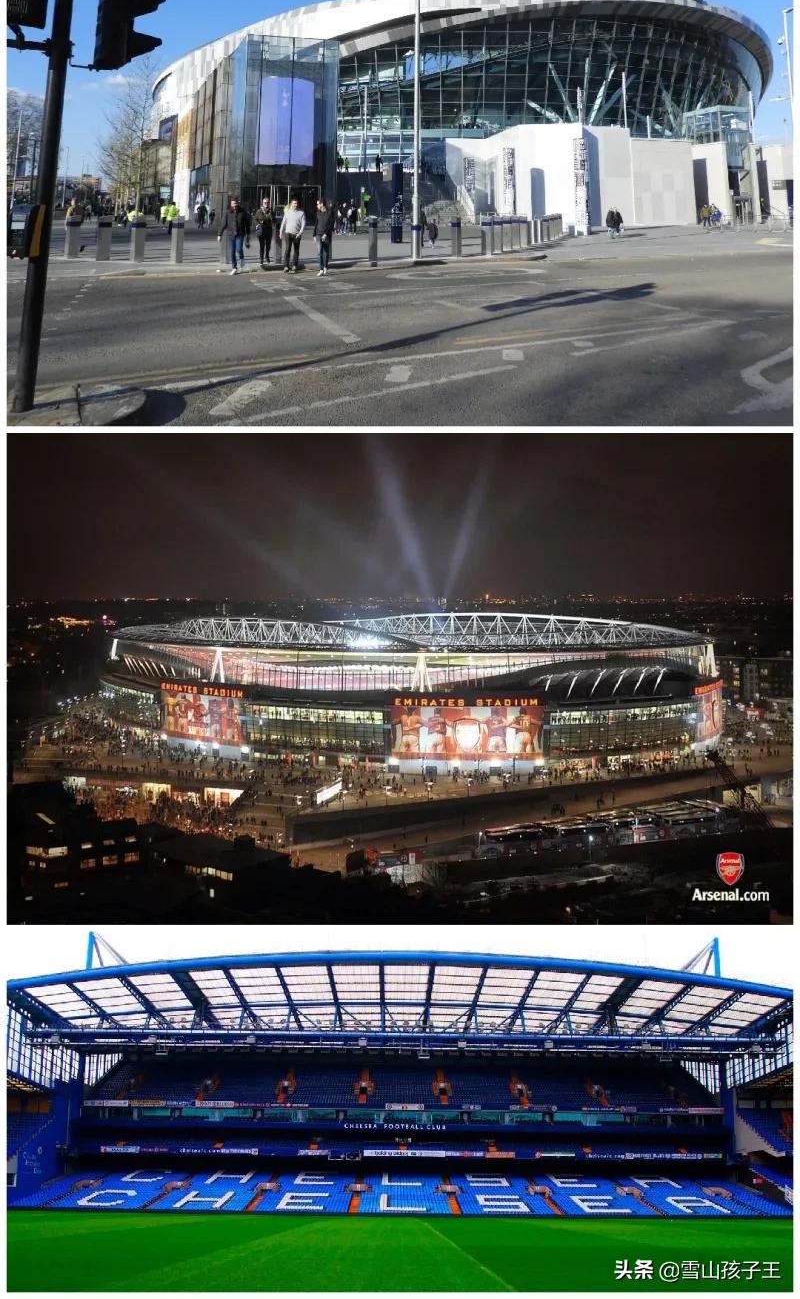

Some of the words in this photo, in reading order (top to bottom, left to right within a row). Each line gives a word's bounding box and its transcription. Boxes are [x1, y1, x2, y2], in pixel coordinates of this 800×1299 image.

[160, 682, 198, 694] EMIRATES
[203, 687, 243, 698] STADIUM
[394, 698, 465, 707] EMIRATES
[476, 698, 538, 707] STADIUM
[121, 1169, 683, 1188] CHELSEA
[77, 1189, 731, 1214] CHELSEA
